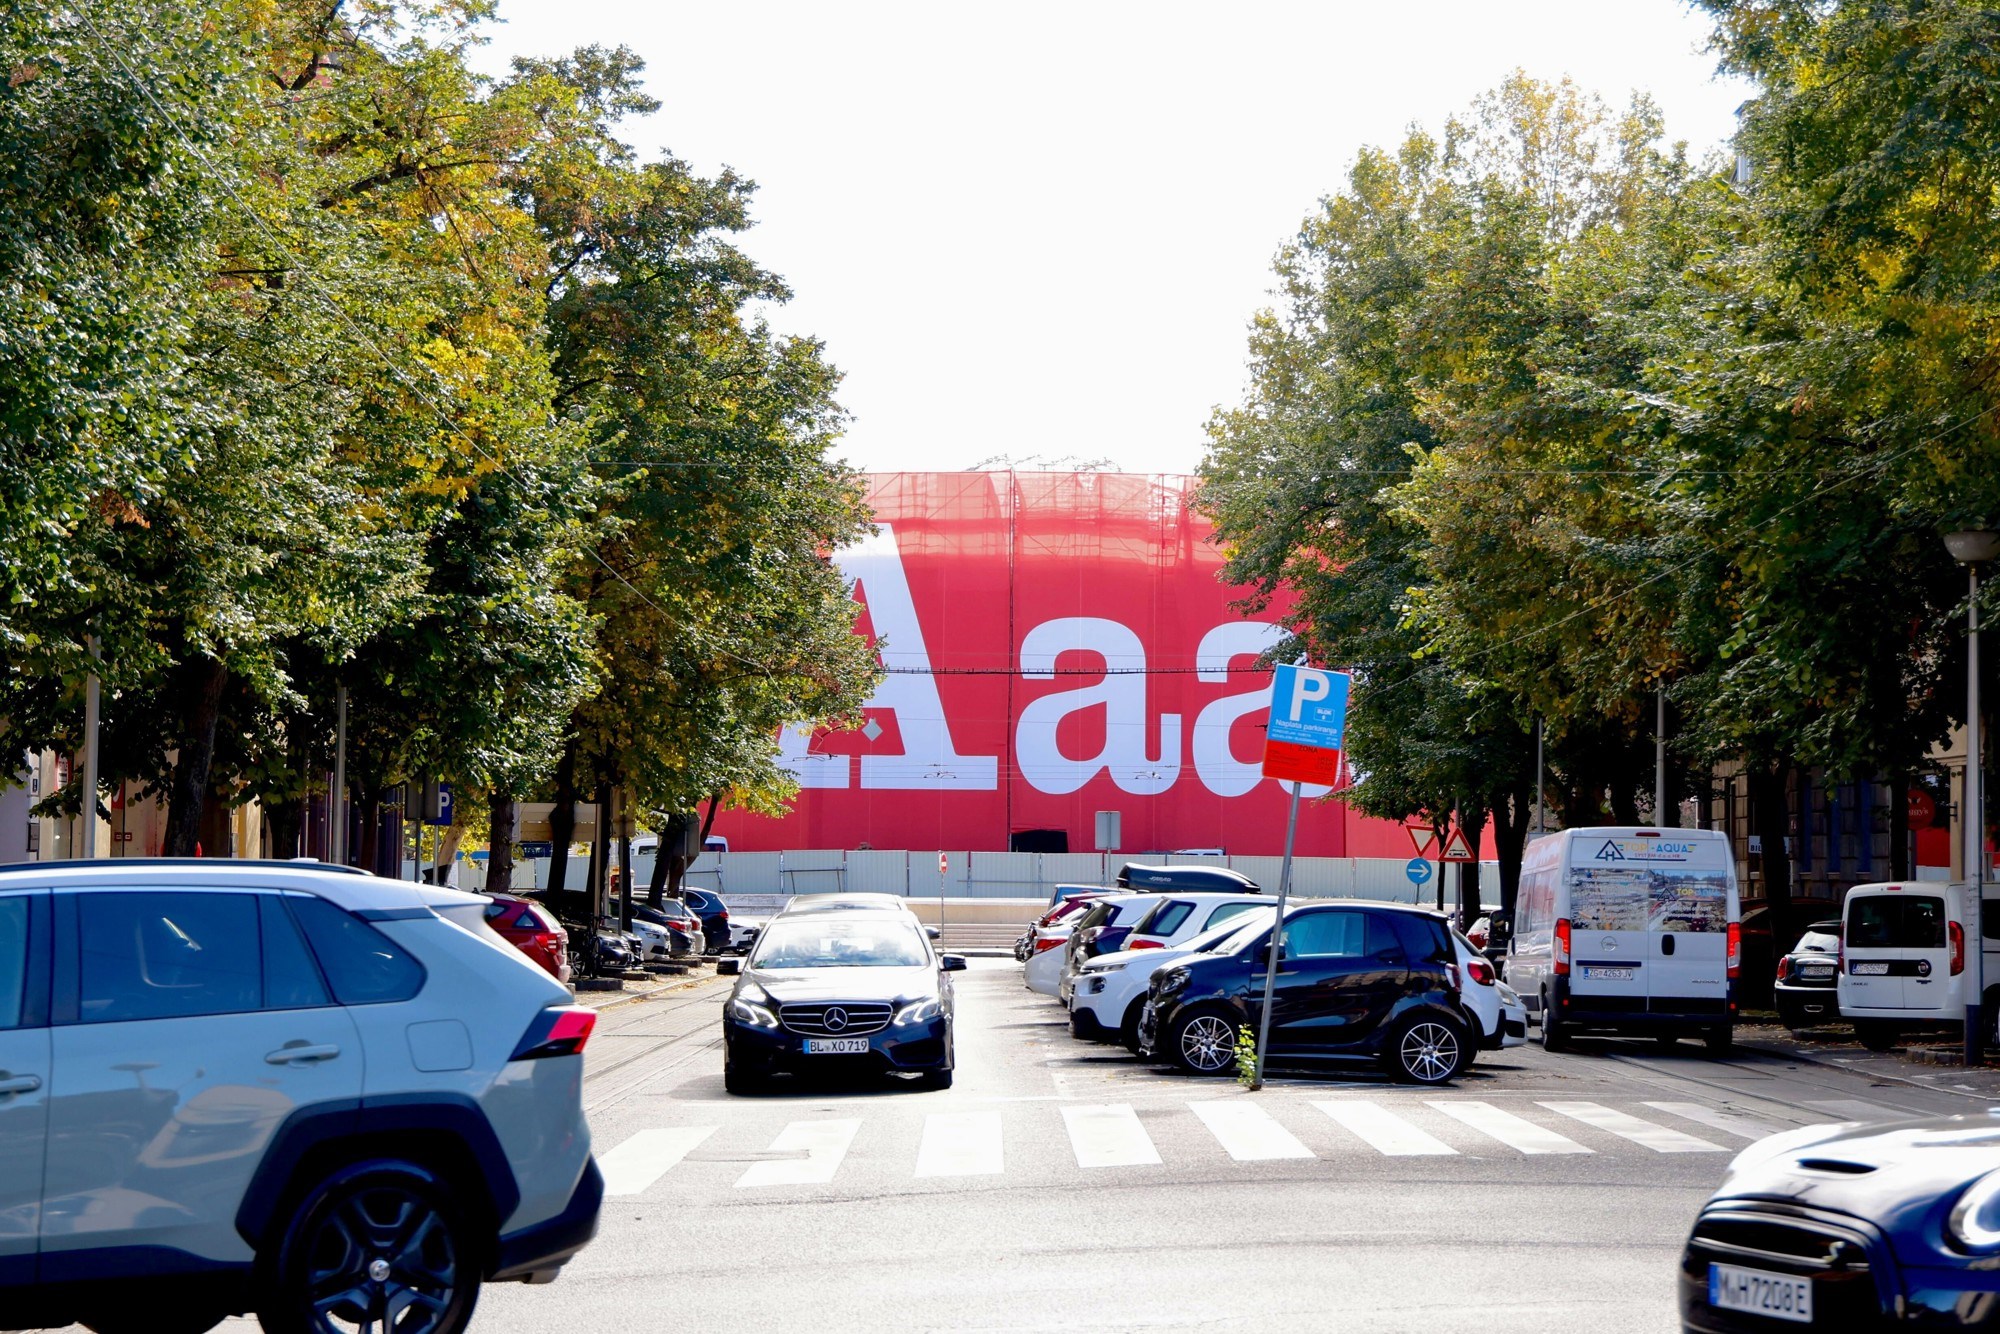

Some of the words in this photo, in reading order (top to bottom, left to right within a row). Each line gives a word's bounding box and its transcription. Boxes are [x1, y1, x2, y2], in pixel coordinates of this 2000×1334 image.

[1289, 669, 1330, 722] P
[1275, 719, 1302, 729] Naplata
[1303, 724, 1337, 735] parkiranja
[1298, 745, 1319, 753] ZONA
[437, 792, 450, 818] P
[1589, 969, 1599, 978] ZG
[810, 1041, 824, 1052] BL
[847, 1040, 867, 1051] 719
